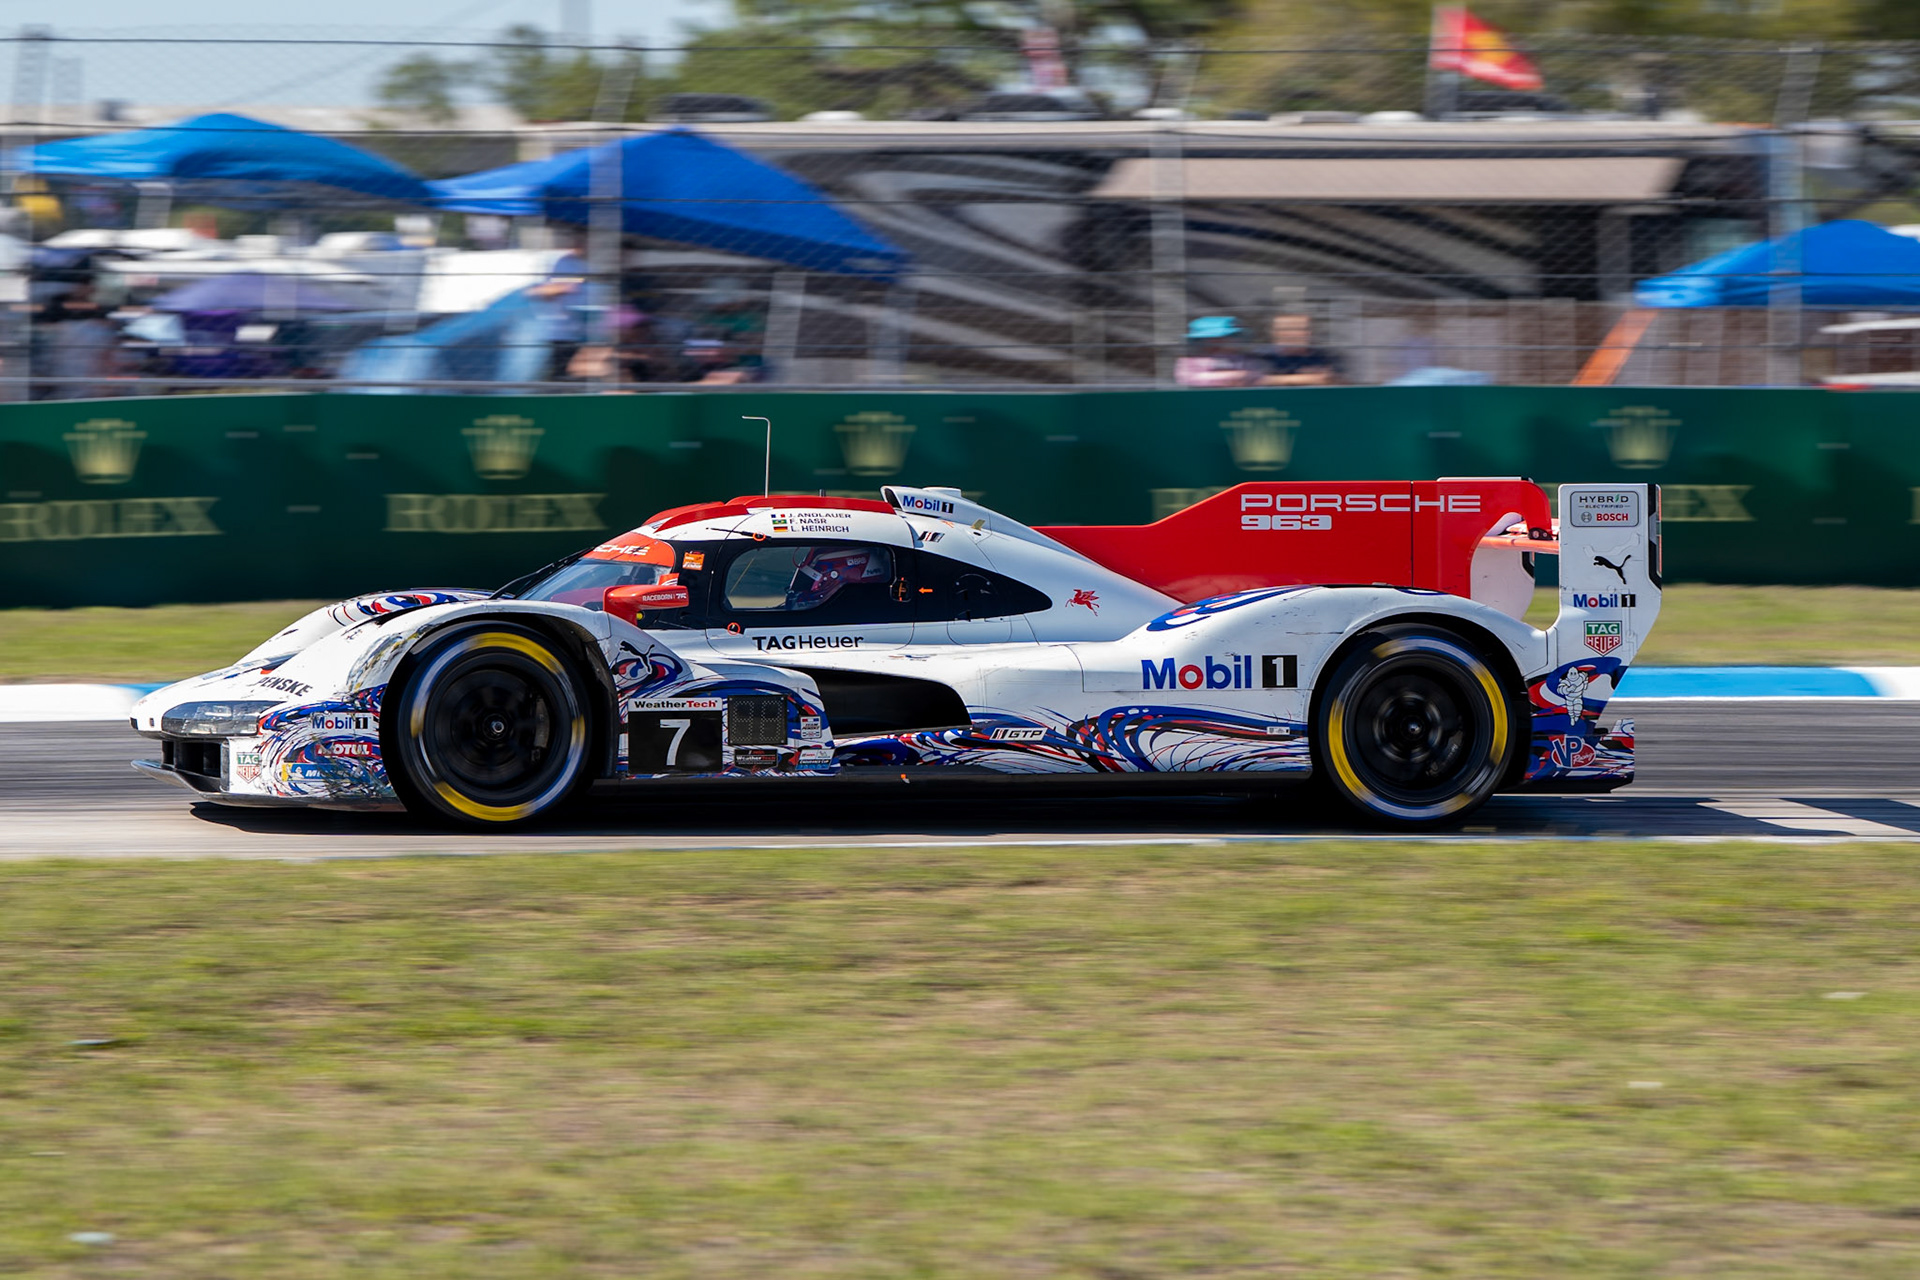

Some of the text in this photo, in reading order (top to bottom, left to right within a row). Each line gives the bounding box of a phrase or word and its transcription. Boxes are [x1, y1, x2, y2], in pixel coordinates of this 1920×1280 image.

[902, 495, 952, 514] Mobil 1
[1240, 494, 1482, 513] PORSCHE
[0, 497, 224, 542] ROLEX
[382, 493, 608, 533] ROLEX
[1596, 513, 1629, 521] BOSCH
[1240, 515, 1332, 530] 963
[1573, 594, 1634, 608] Mobil 1
[1588, 624, 1618, 634] TAG
[1587, 636, 1620, 653] HEUER
[1141, 654, 1252, 690] Mobil
[259, 676, 313, 697] PENSKE
[634, 700, 718, 709] WeatherTech
[312, 716, 367, 730] Mobil 1
[660, 719, 690, 766] 7
[1008, 730, 1043, 738] GTP
[238, 755, 260, 765] TAG
[1552, 735, 1583, 768] VP
